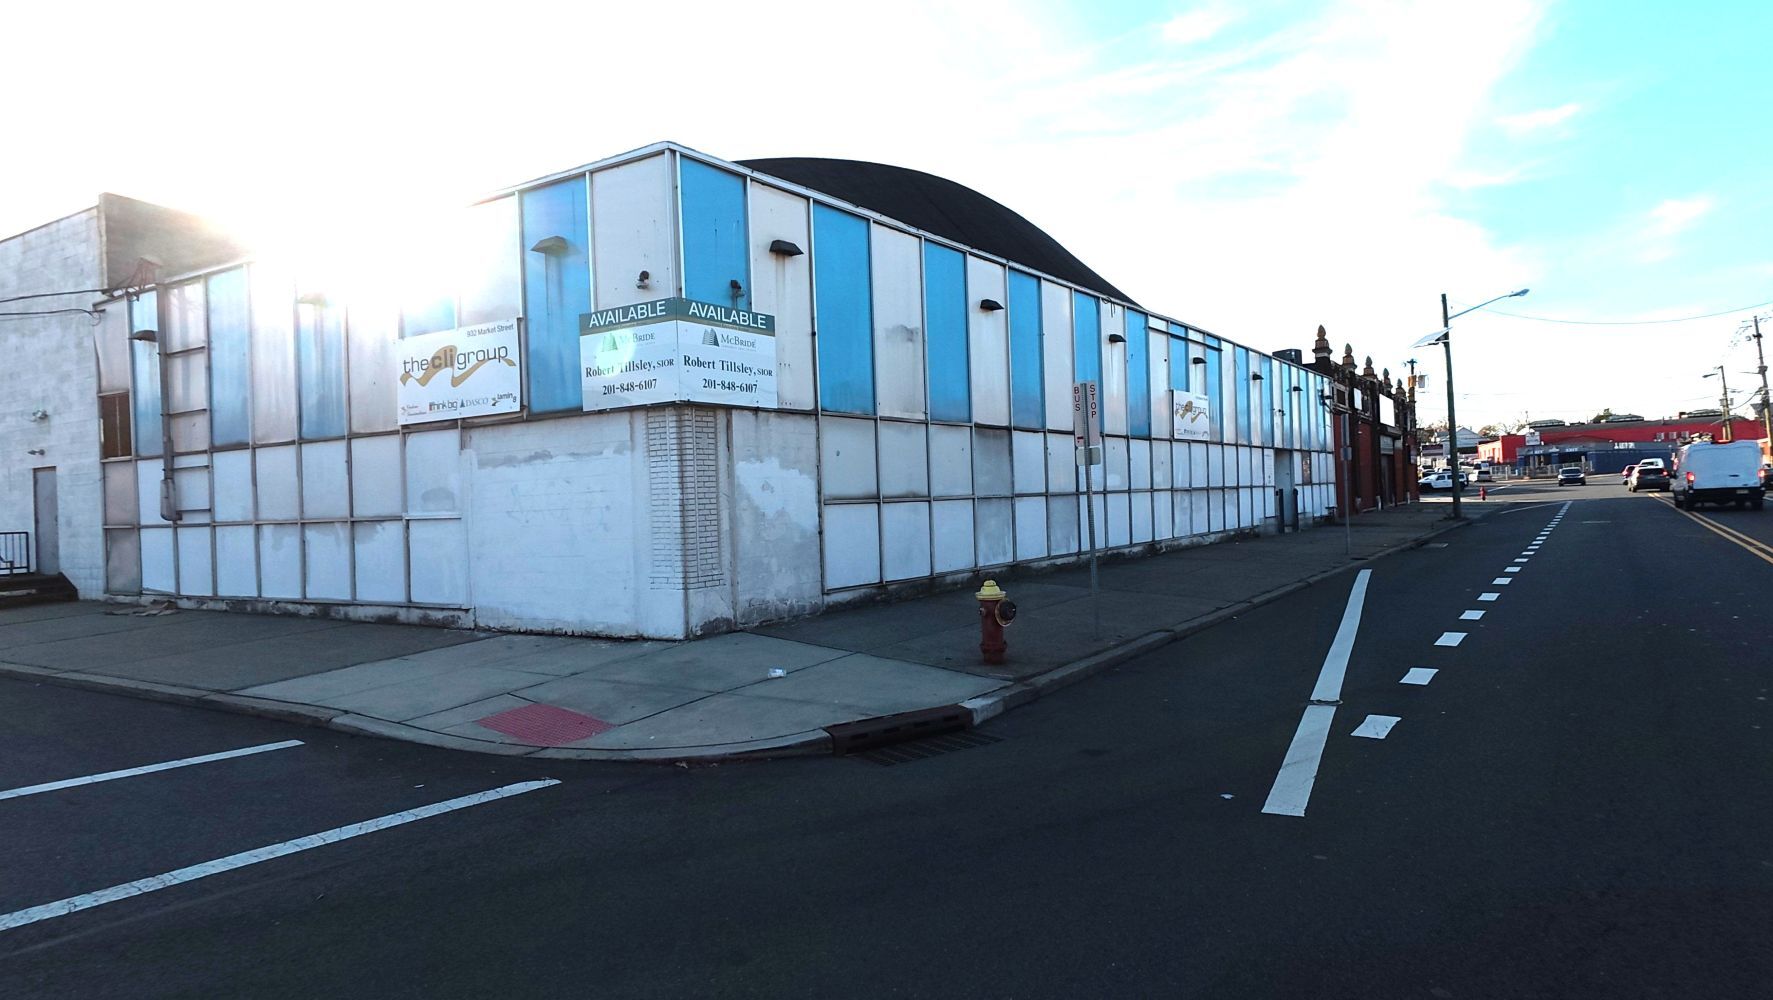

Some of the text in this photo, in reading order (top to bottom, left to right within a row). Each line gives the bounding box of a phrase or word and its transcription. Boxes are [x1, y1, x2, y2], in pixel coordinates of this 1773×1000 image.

[589, 300, 666, 328] AVAILABLE
[688, 302, 767, 329] AVAILABLE
[478, 326, 496, 335] Market
[497, 323, 514, 332] Street
[585, 358, 675, 378] Robert Tillsley, SIOR
[683, 355, 773, 377] Robert Tillsley, SIOR
[602, 378, 657, 395] 201-848-6107
[702, 378, 758, 393] 201-848-6107
[1073, 386, 1081, 412] BUS
[1089, 384, 1097, 419] STOP
